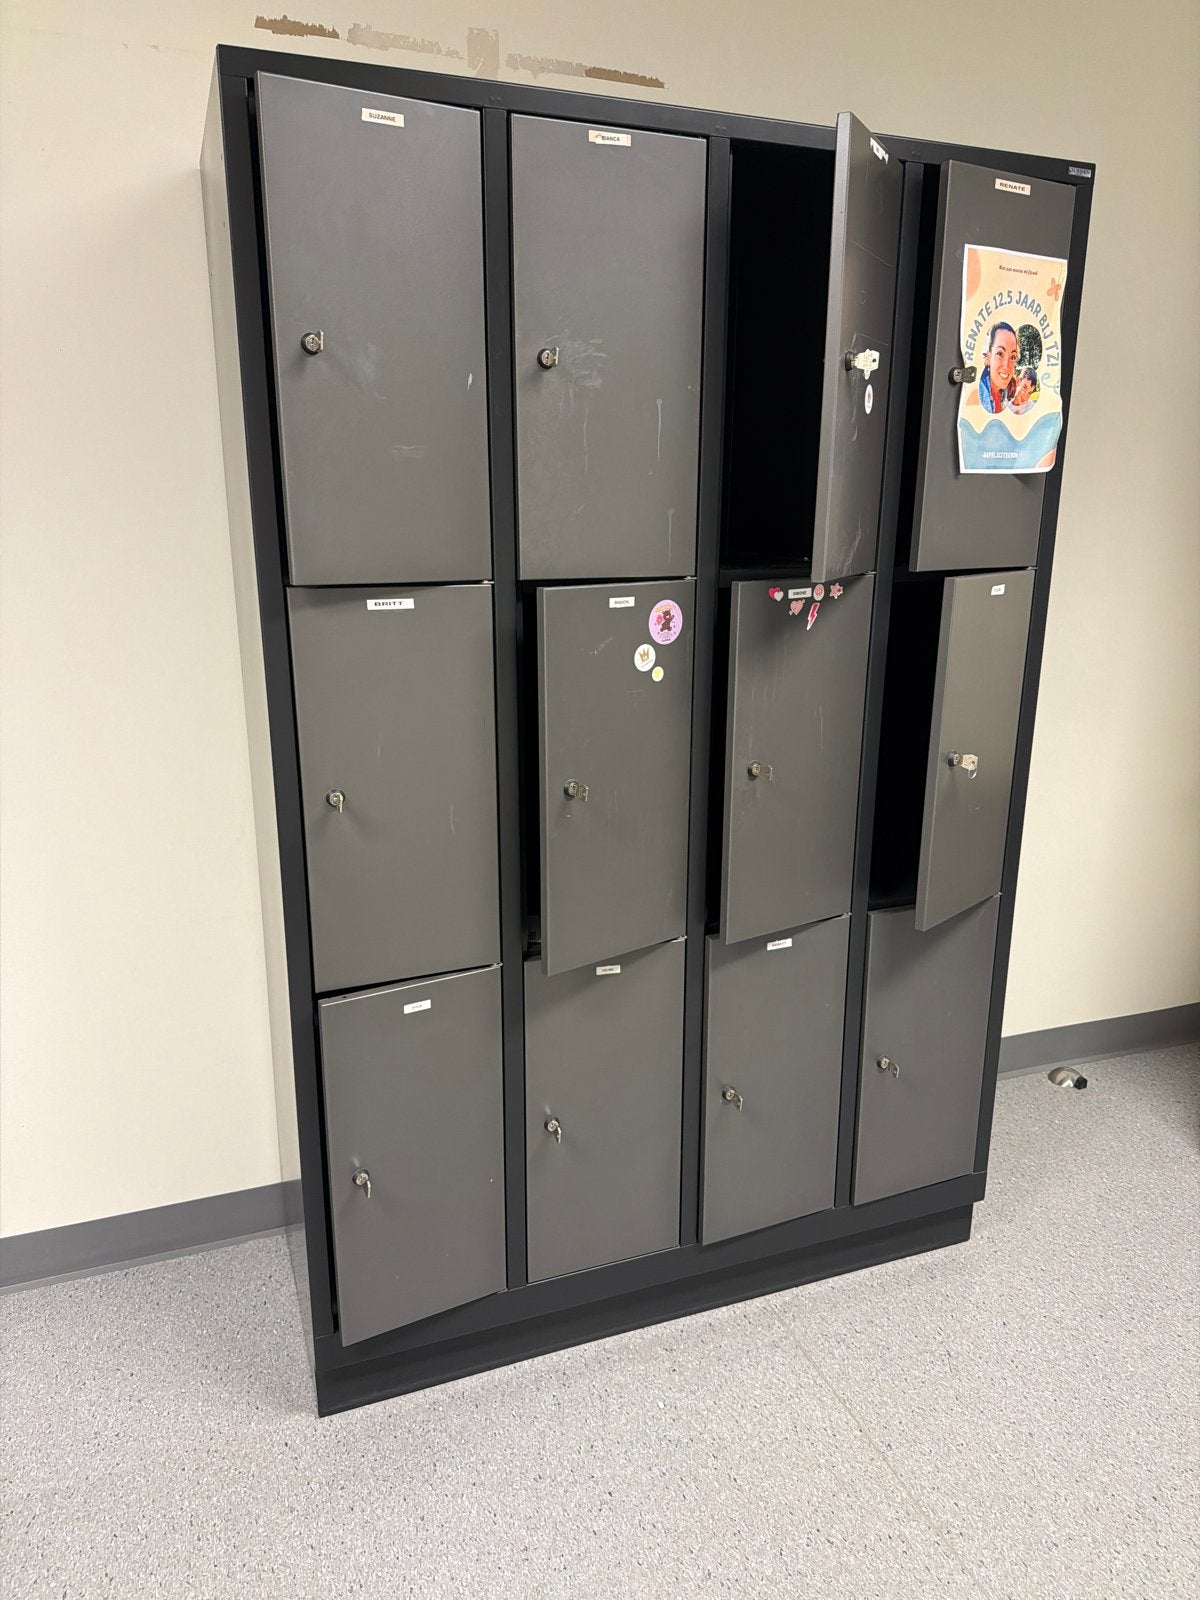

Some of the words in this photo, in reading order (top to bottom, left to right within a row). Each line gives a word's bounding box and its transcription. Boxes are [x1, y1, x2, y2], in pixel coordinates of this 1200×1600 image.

[368, 112, 396, 123] SUZANNE
[999, 182, 1026, 192] RENATE
[993, 290, 1013, 310] 12.5
[1015, 291, 1041, 318] JAAR
[965, 301, 992, 361] RENATE
[1039, 314, 1054, 340] BIJ
[1045, 341, 1060, 367] TZ!
